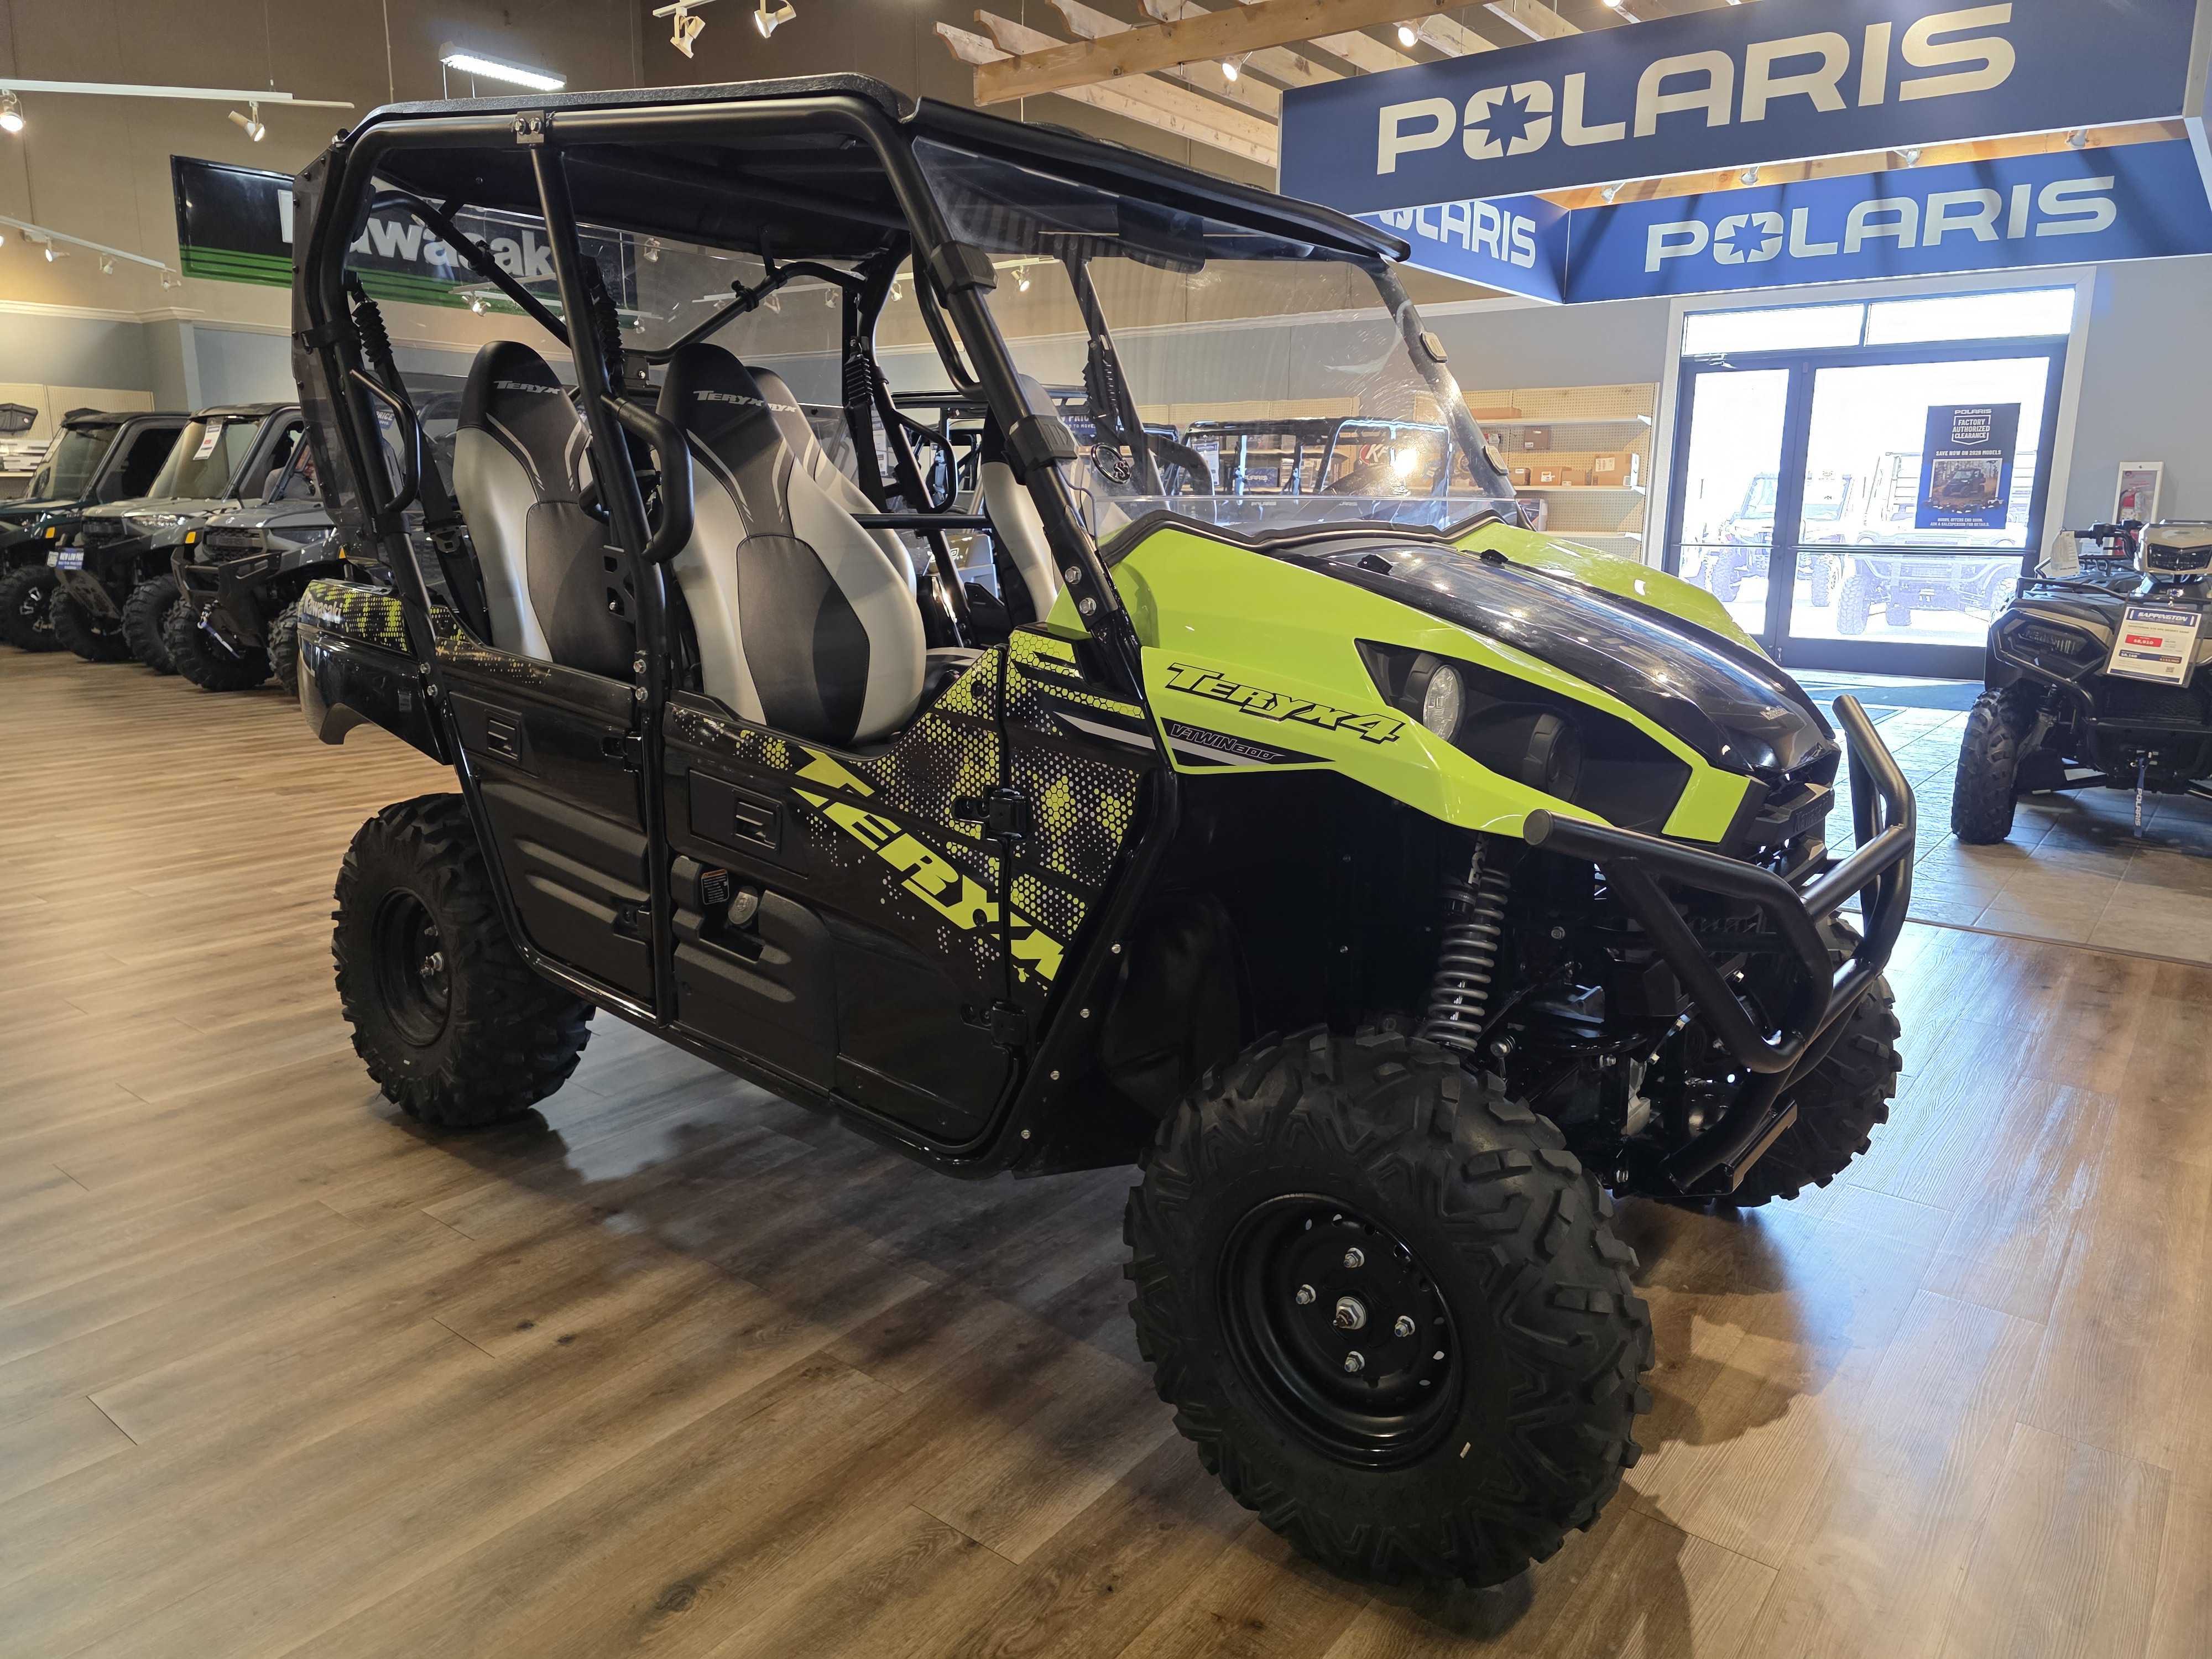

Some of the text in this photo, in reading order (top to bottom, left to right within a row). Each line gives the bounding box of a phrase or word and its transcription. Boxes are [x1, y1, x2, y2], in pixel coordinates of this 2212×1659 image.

[1377, 3, 2016, 175] POLARIS
[1379, 201, 1536, 269] LARIS
[1645, 176, 2117, 274] POLARIS
[493, 380, 561, 395] TERYX
[693, 390, 766, 407] TERYX
[768, 403, 797, 413] RYX
[304, 592, 343, 624] Kawasaki
[2137, 612, 2188, 622] SAPPINGTON
[1165, 662, 1406, 745] TERYX4
[1170, 724, 1287, 761] V-TWIN 800
[790, 744, 1065, 982] TERYX
